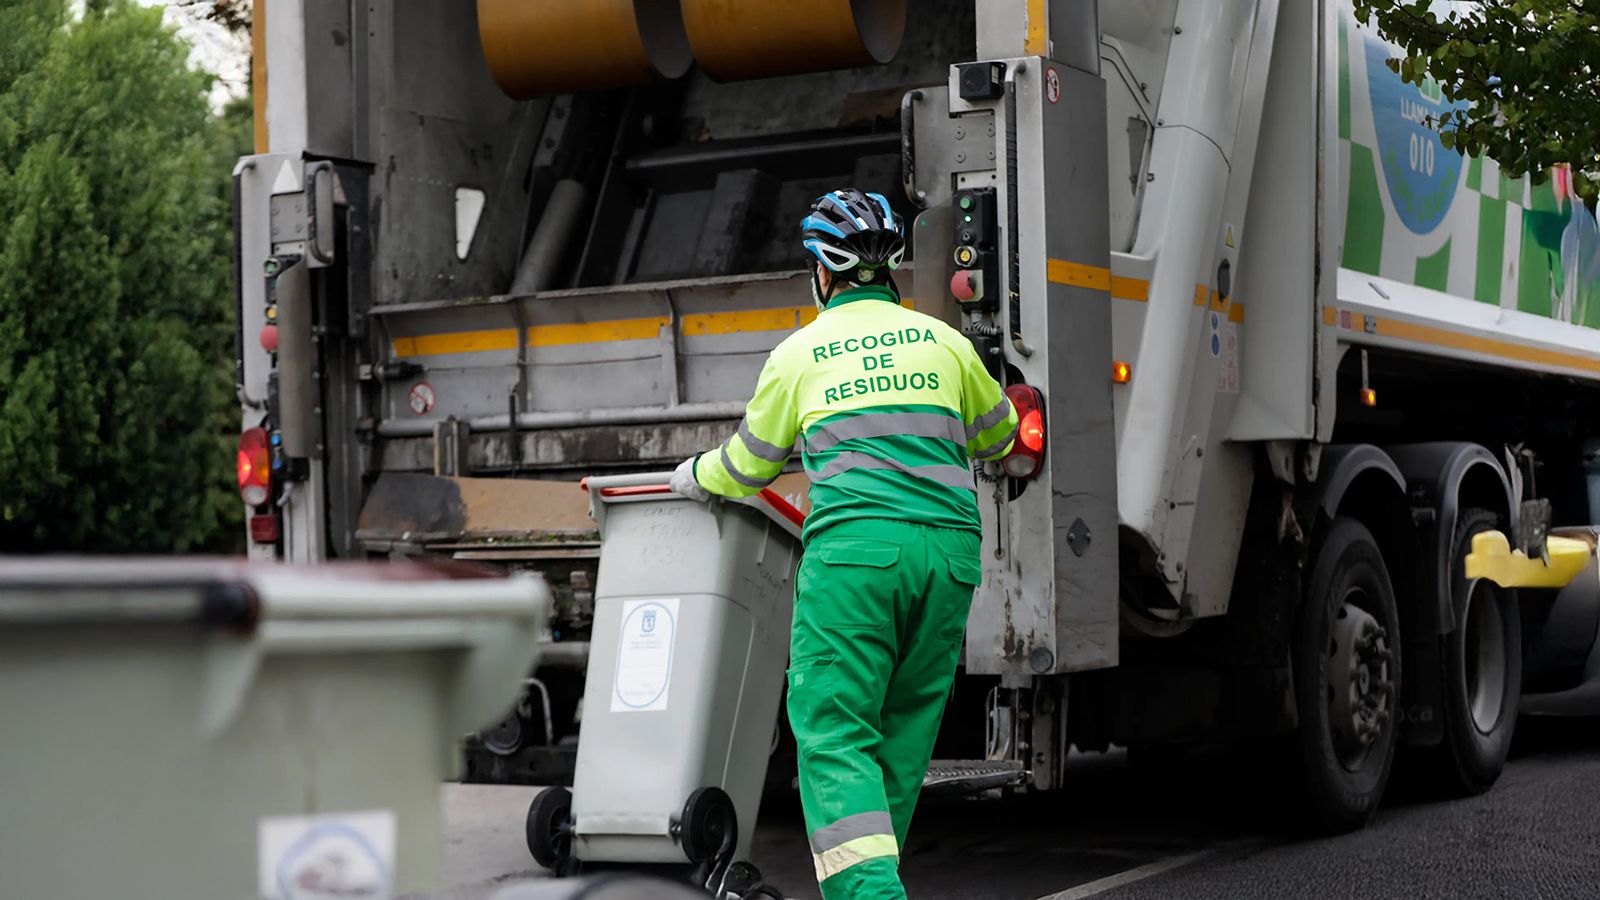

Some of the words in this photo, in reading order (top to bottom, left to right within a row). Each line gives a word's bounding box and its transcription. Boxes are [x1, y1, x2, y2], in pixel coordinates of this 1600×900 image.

[1409, 132, 1434, 177] 010
[812, 328, 937, 363] RECOGIDA
[863, 353, 894, 371] DE
[825, 372, 939, 404] RESIDUOS
